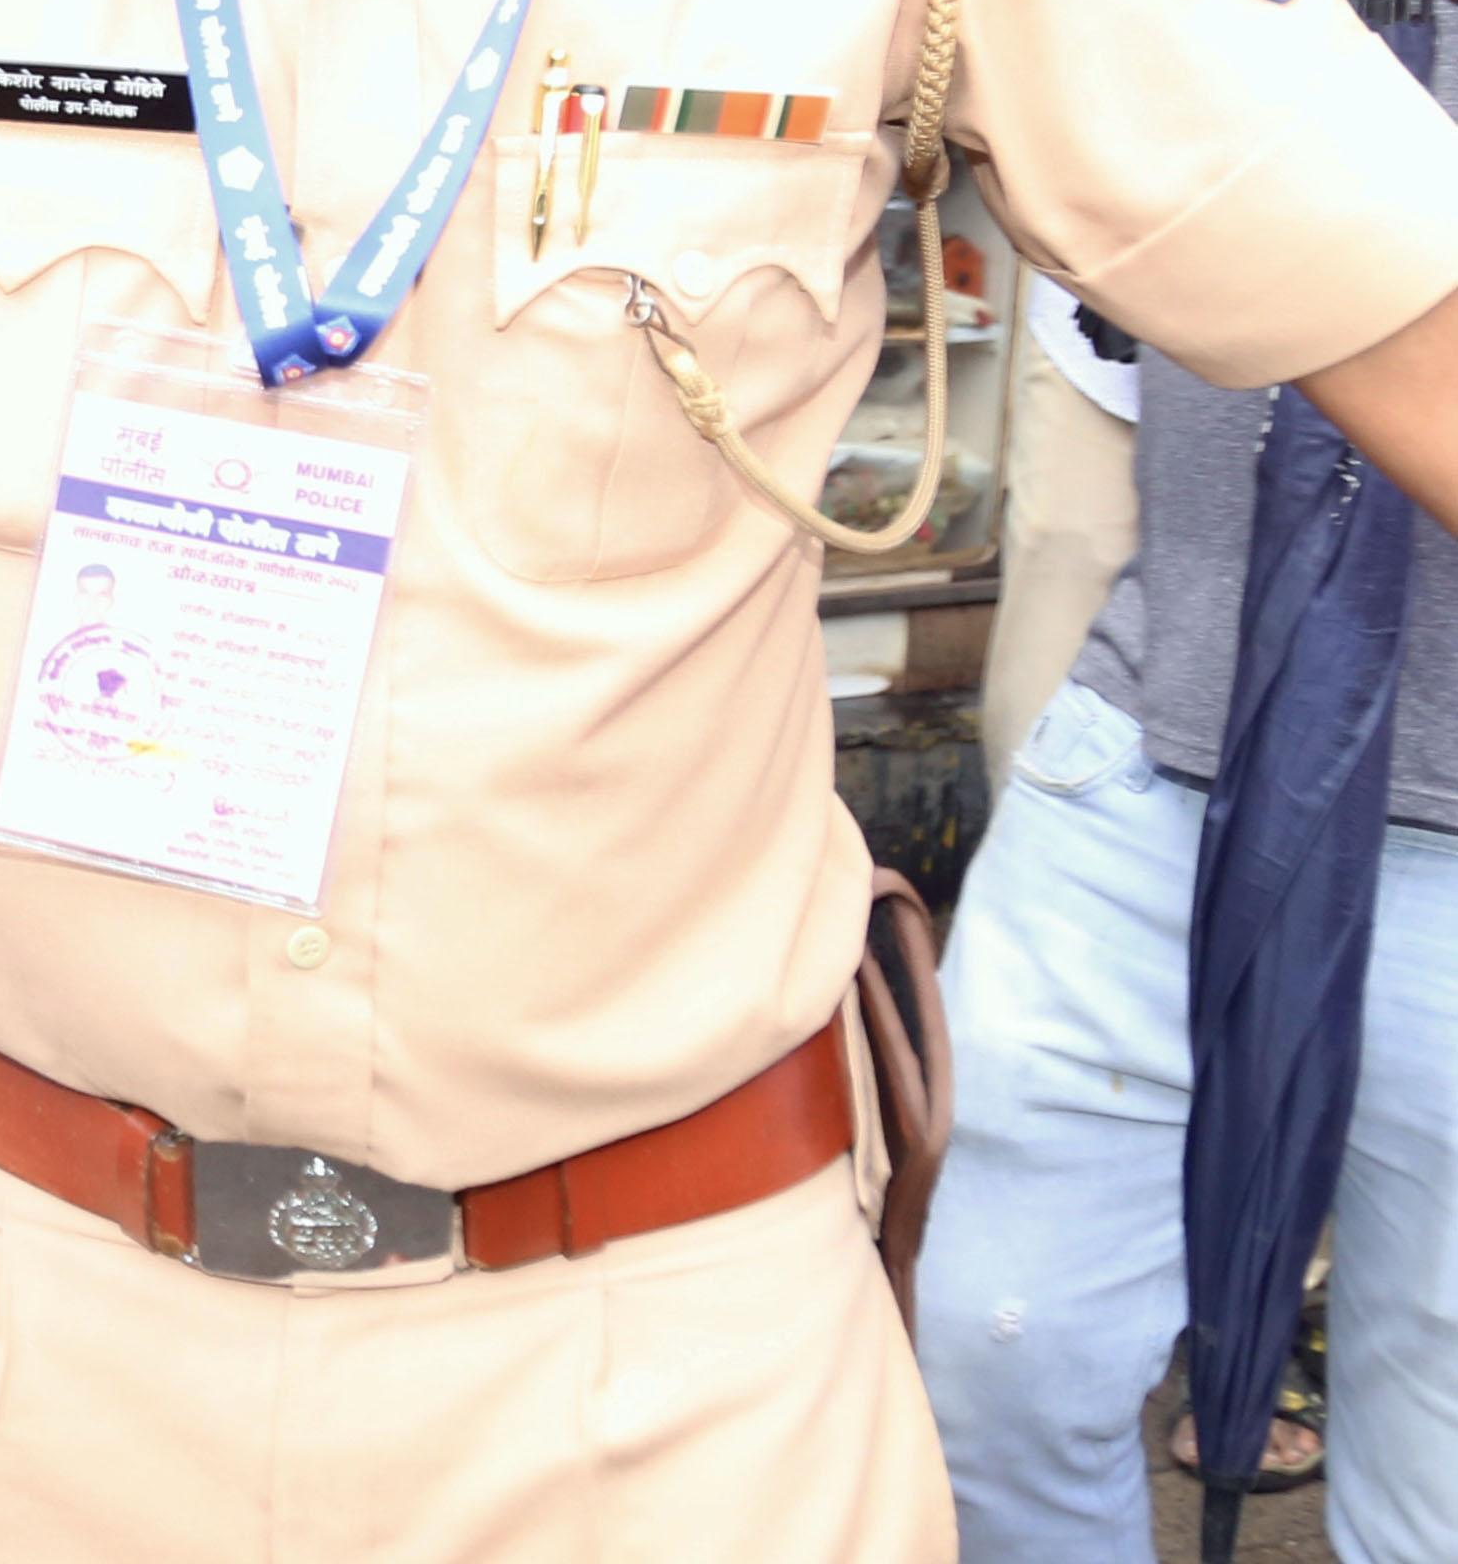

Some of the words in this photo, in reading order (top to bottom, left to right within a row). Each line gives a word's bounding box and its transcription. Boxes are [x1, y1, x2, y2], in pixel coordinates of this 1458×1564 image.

[112, 75, 168, 99] मोहिते
[17, 94, 61, 114] पोलीस
[99, 453, 168, 487] पोलीस
[294, 460, 375, 489] MUMBAI
[293, 487, 364, 515] POLICE
